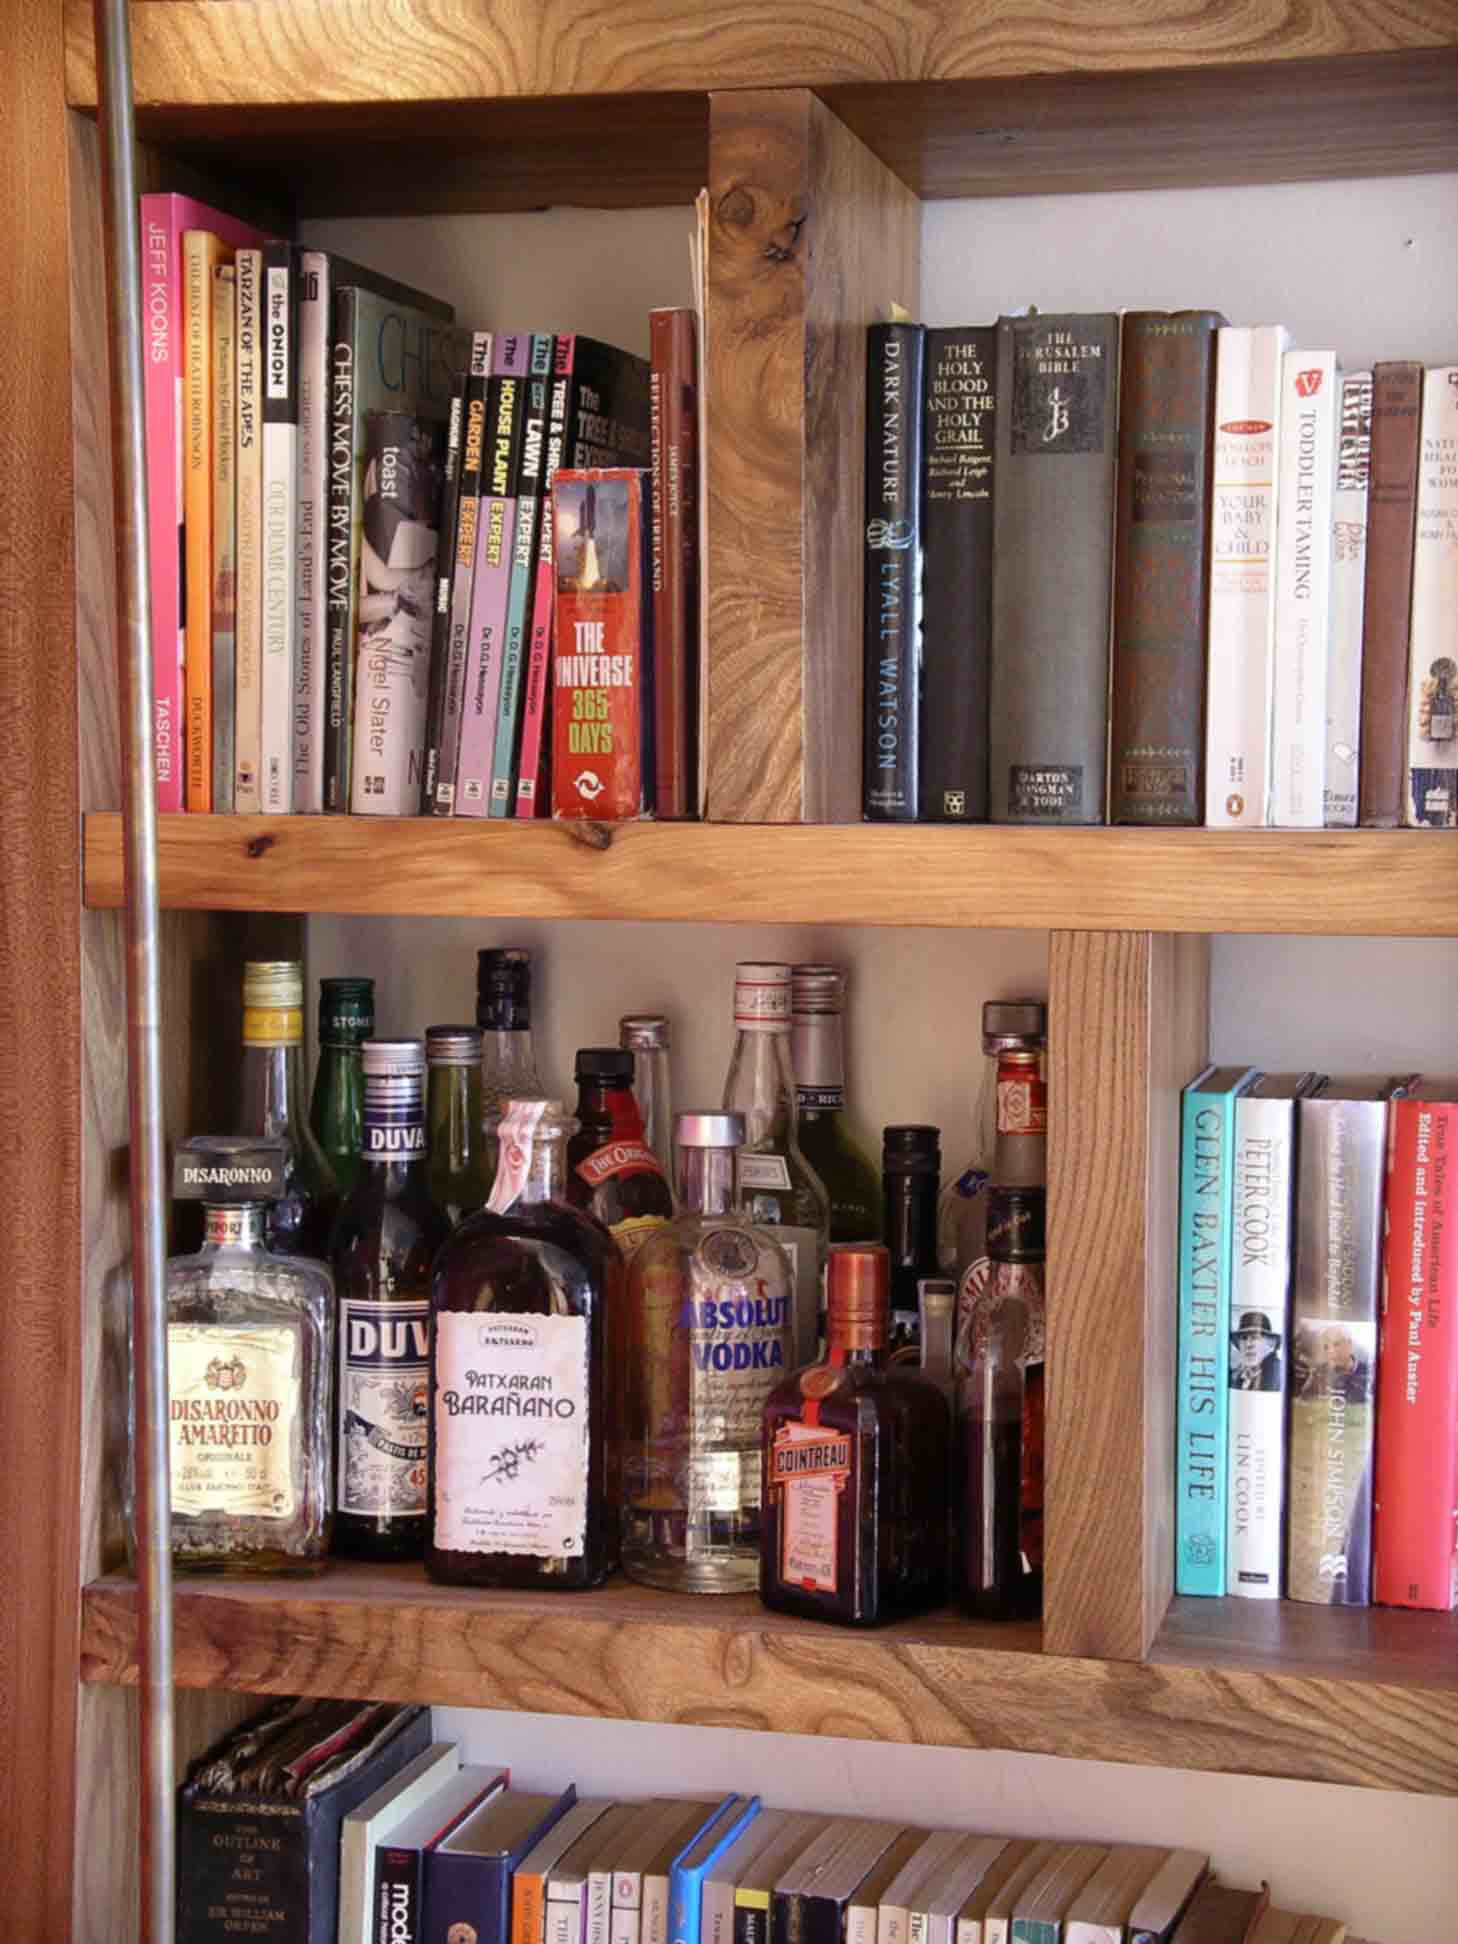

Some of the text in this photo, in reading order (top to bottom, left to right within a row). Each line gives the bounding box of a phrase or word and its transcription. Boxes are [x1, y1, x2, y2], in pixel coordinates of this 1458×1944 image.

[148, 222, 168, 364] JEFF KOONS
[240, 255, 254, 448] TARZAN OF THE APES
[271, 293, 285, 386] the ONION
[536, 337, 550, 370] The
[555, 337, 571, 370] The
[944, 344, 976, 358] THE
[938, 361, 983, 375] HOLY
[1039, 361, 1080, 374] BIBLE
[550, 379, 567, 420] TREE
[927, 396, 994, 411] AND THE
[933, 379, 988, 393] BLOOD
[550, 421, 563, 434] &
[882, 342, 901, 503] DARK NATURE
[935, 429, 983, 443] GRAIL
[937, 413, 982, 428] HOLY
[457, 339, 488, 568] The GARDEN EXPERT
[487, 336, 518, 567] The HOUSE PLANT EXPERT
[522, 418, 542, 477] LAWN
[1297, 409, 1318, 513] TODDLER
[328, 343, 354, 613] CHESS MOVE BY MOVE
[380, 446, 399, 500] toast
[650, 492, 661, 513] OF
[516, 500, 535, 568] EXPERT
[650, 519, 662, 592] IRELAND
[1294, 520, 1313, 600] TAMING
[268, 576, 287, 656] CENTURY
[880, 563, 899, 641] LYALL
[574, 621, 605, 654] THE
[368, 637, 393, 758] Nigel Slater
[572, 688, 608, 721] 365
[879, 657, 898, 768] WATSON
[156, 696, 170, 782] TASCHEN
[568, 722, 614, 755] DAYS
[370, 1127, 426, 1149] DUVA
[1416, 1112, 1431, 1163] Edited
[183, 1167, 272, 1187] DISARONNO
[1415, 1167, 1428, 1196] and
[1241, 1137, 1273, 1267] PETER COOK
[677, 1294, 791, 1329] ABSOLUT
[1188, 1107, 1222, 1500] GLEN BAXTER HIS LIFE
[1408, 1287, 1423, 1306] by
[1407, 1311, 1422, 1345] Paul
[692, 1340, 784, 1371] VODKA
[464, 1369, 553, 1392] PATXARAN
[1406, 1351, 1421, 1404] Auster
[169, 1399, 280, 1422] DISARONNO
[441, 1391, 576, 1419] BARAÑANO
[177, 1423, 273, 1448] AMARETTO
[776, 1443, 848, 1472] COINTREAU
[1328, 1389, 1346, 1537] JOHN SIMPSON
[1235, 1433, 1251, 1537] LIN COOK
[231, 1867, 264, 1881] ART
[392, 1883, 412, 1944] mod
